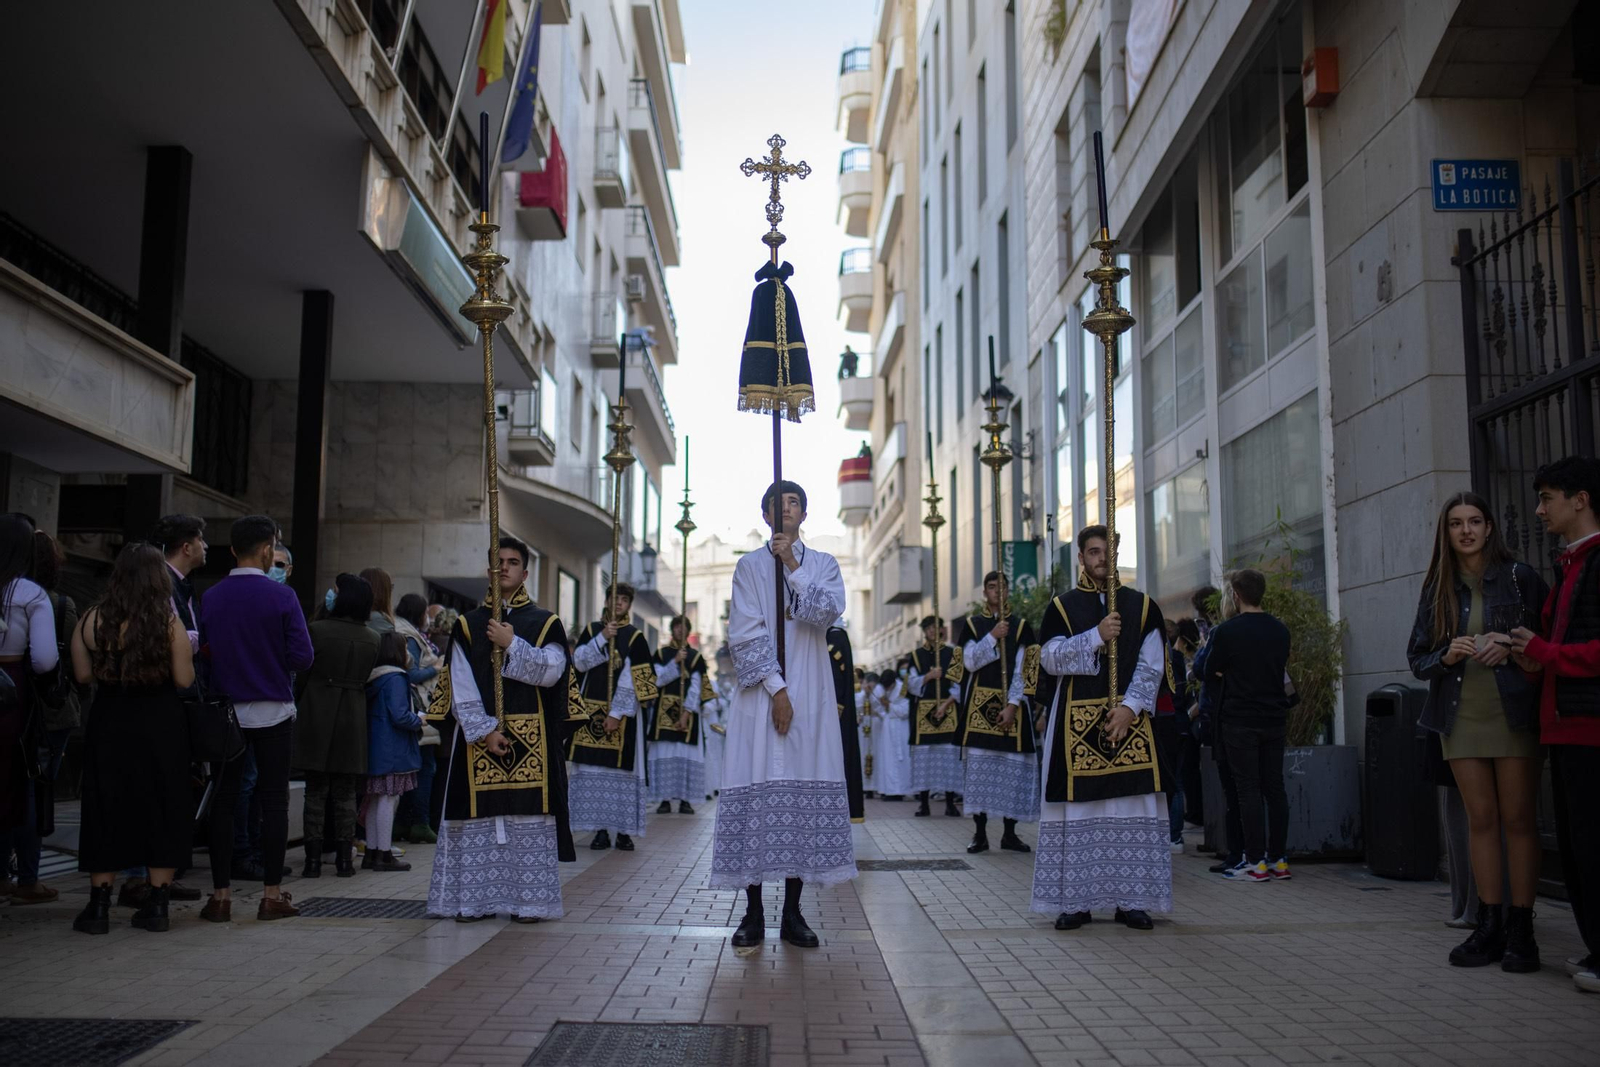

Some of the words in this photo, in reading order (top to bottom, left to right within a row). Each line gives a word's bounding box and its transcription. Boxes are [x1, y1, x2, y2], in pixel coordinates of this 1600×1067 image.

[1462, 167, 1508, 179] PASAJE
[1440, 189, 1457, 203] LA
[1463, 189, 1516, 203] BOTICA
